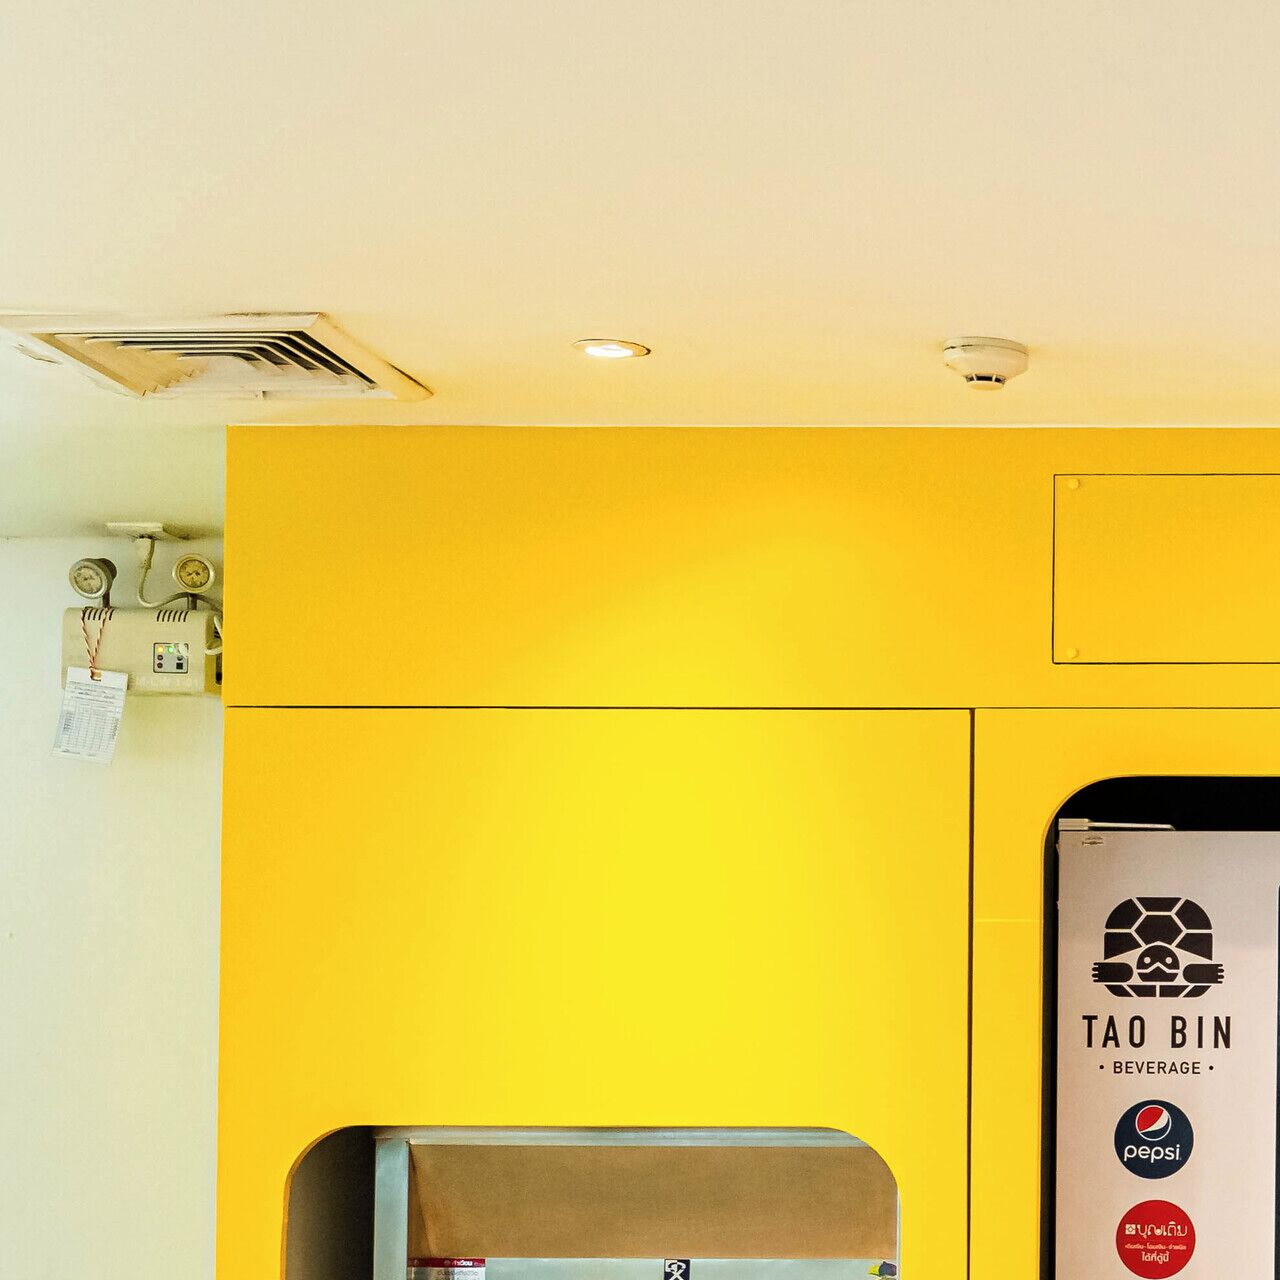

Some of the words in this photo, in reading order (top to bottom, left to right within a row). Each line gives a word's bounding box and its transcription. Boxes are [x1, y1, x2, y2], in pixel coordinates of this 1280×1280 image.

[1082, 1015, 1146, 1048] TAO
[1171, 1015, 1231, 1048] BIN
[1113, 1061, 1201, 1075] BEVERAGE
[1124, 1143, 1182, 1163] pepsi
[1137, 1221, 1188, 1239] บุญเติม
[1142, 1251, 1169, 1264] ได้ที่ตู้นี้
